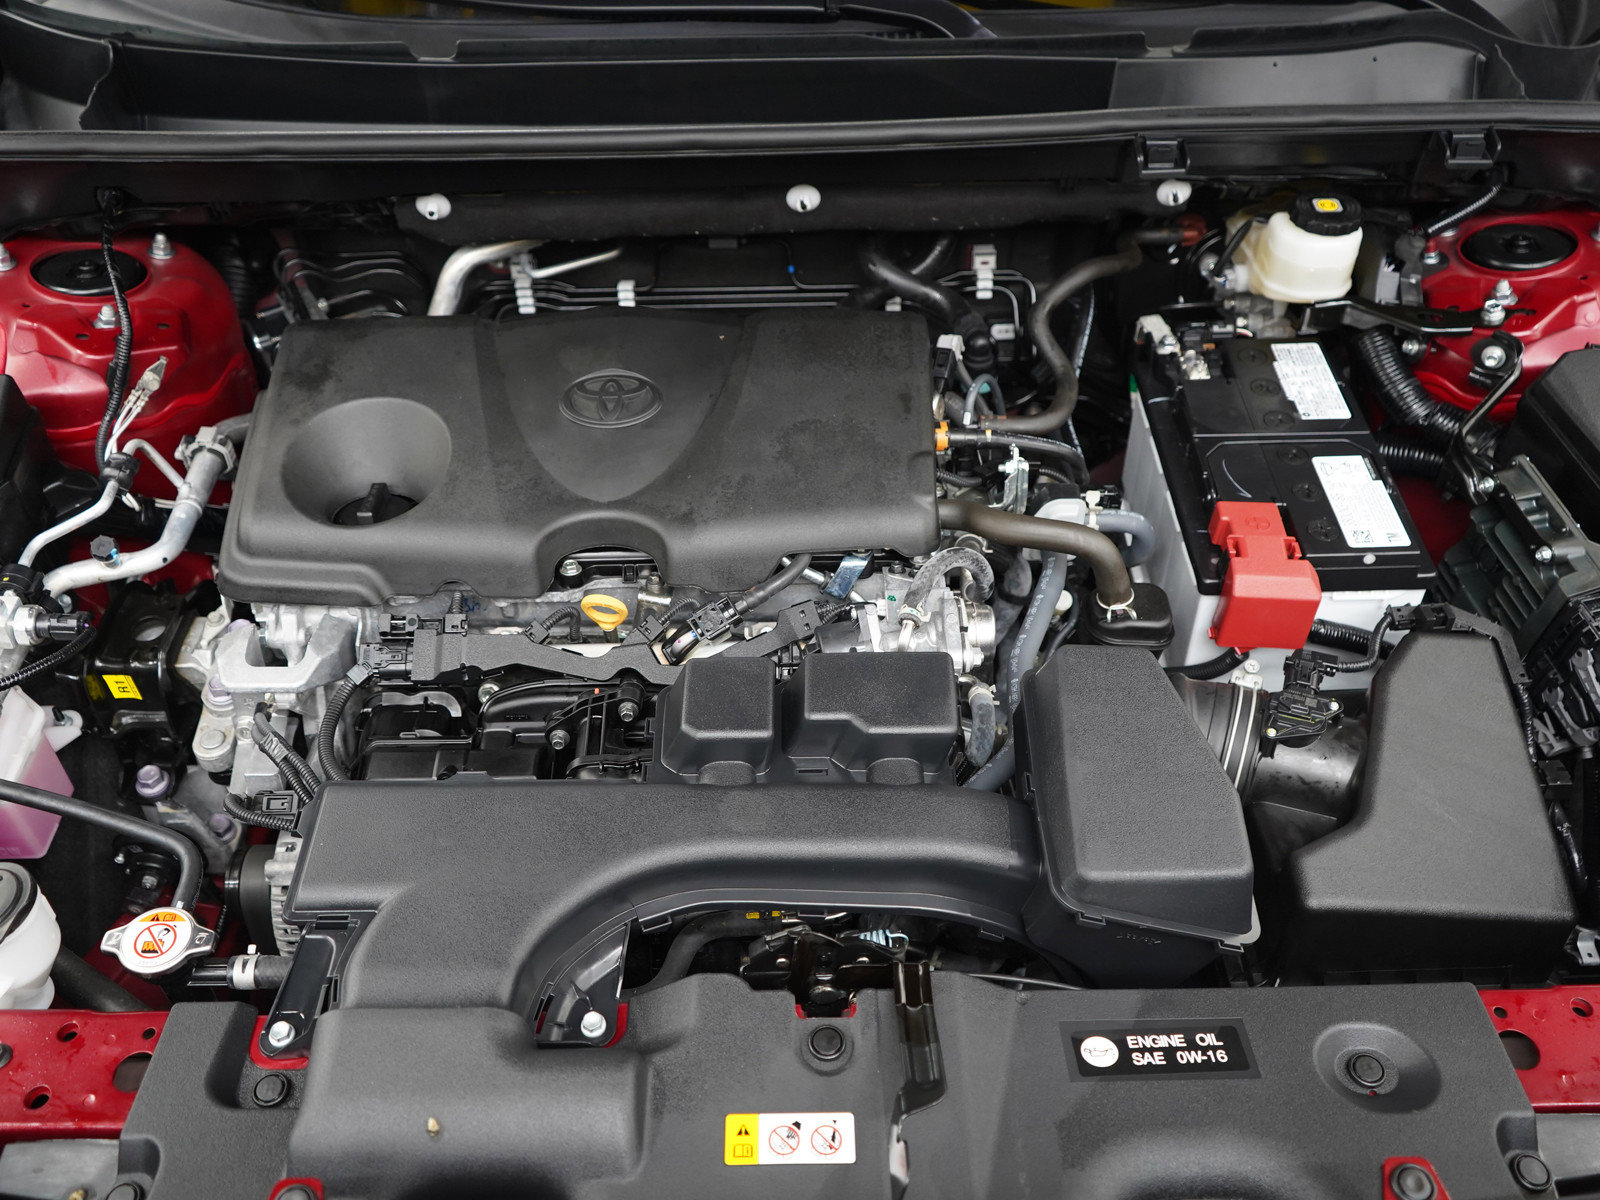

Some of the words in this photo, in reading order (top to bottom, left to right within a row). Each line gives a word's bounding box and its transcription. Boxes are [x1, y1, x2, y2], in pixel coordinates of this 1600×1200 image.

[1126, 1034, 1187, 1049] ENGINE
[1195, 1032, 1224, 1047] OIL
[1131, 1051, 1167, 1066] SAE
[1176, 1050, 1229, 1065] 0W-16
